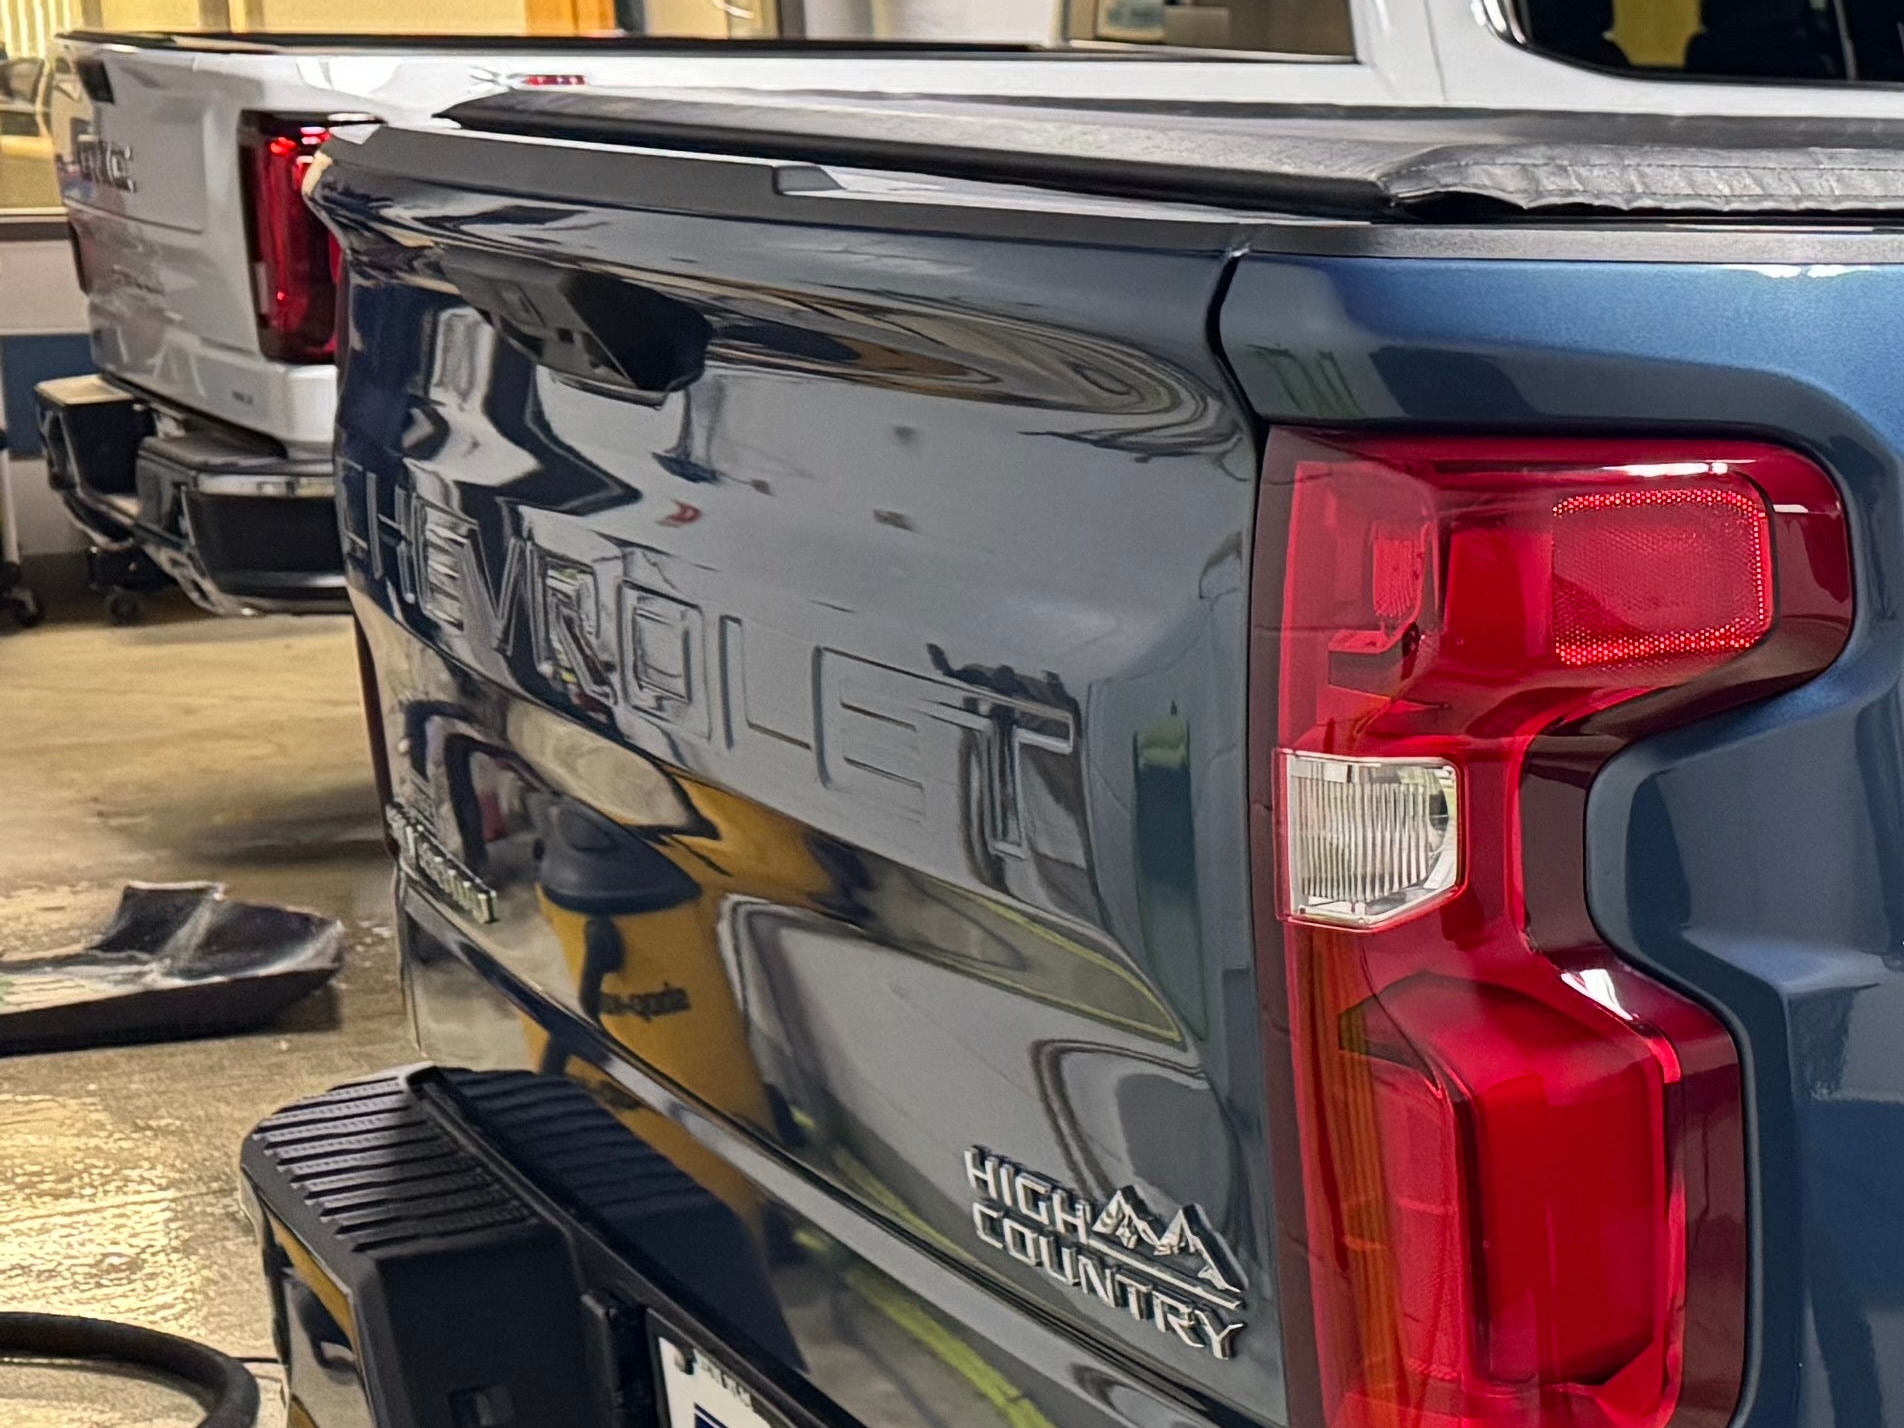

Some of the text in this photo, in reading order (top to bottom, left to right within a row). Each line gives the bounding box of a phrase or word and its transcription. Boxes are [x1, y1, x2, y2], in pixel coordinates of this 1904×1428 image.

[335, 456, 1076, 859] CHEVROLET
[964, 1145, 1091, 1245] HIGH
[972, 1200, 1247, 1360] COUNTRY
